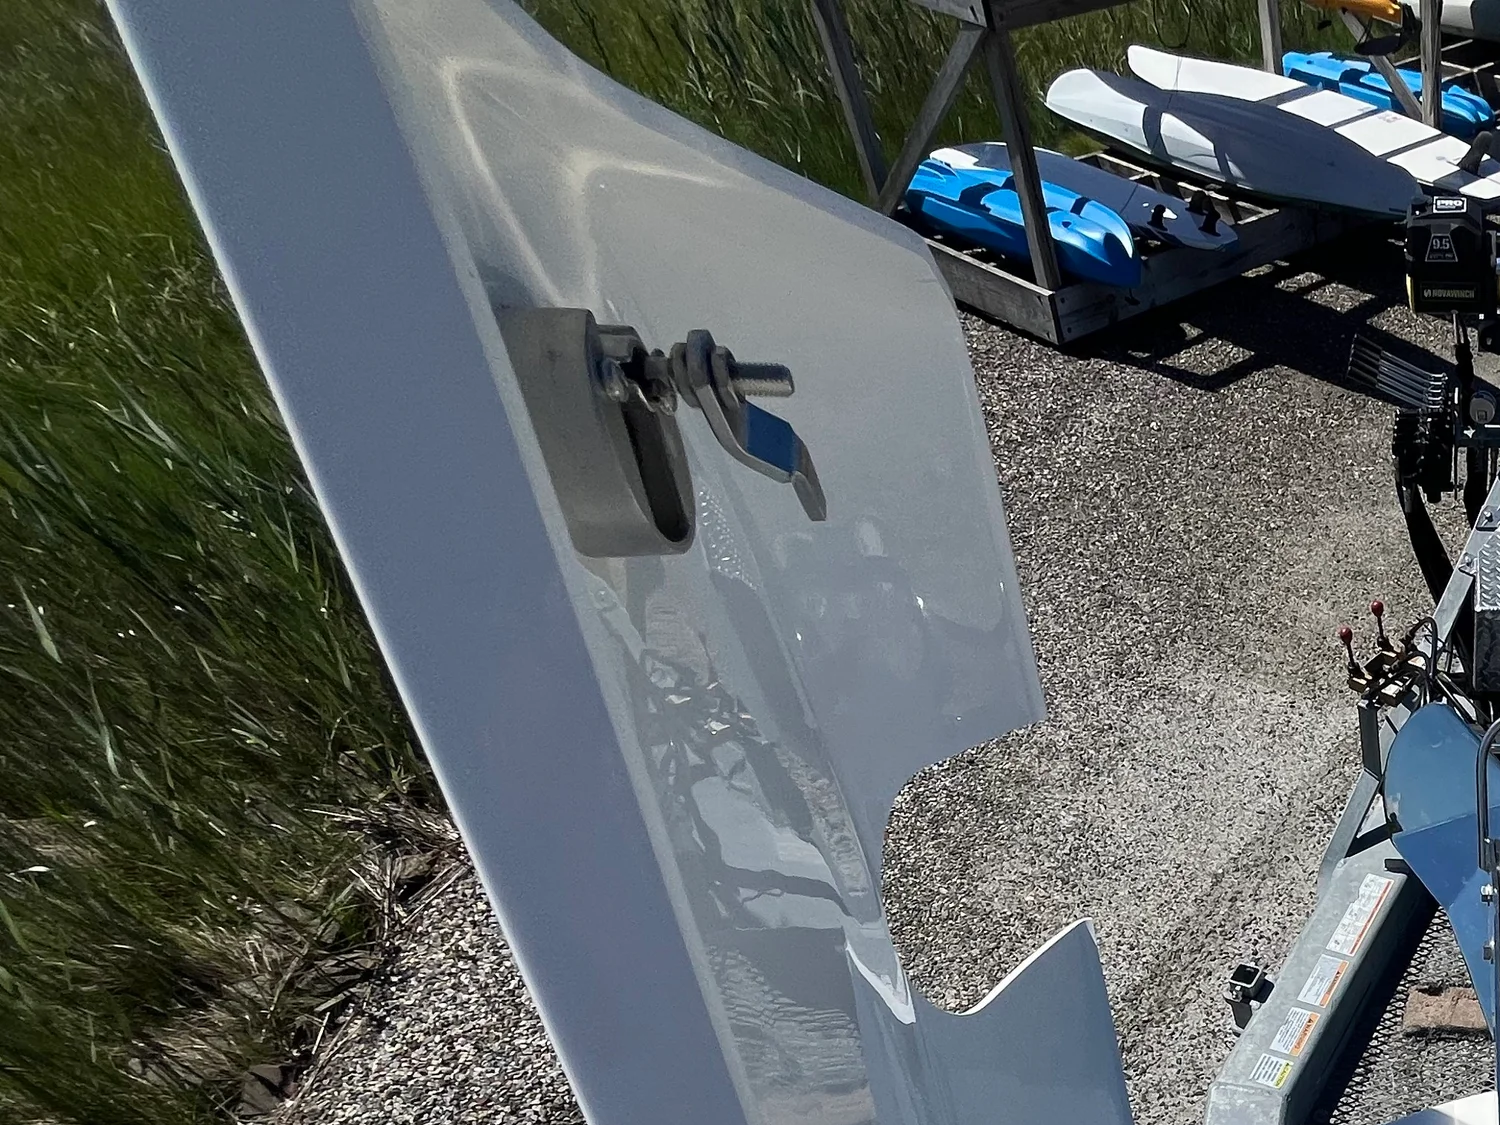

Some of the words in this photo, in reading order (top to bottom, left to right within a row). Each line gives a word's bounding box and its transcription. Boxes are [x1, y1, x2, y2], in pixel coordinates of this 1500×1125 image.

[1436, 199, 1463, 207] PRO
[1432, 238, 1450, 250] 9.5
[1432, 288, 1475, 298] NOVAWINCH
